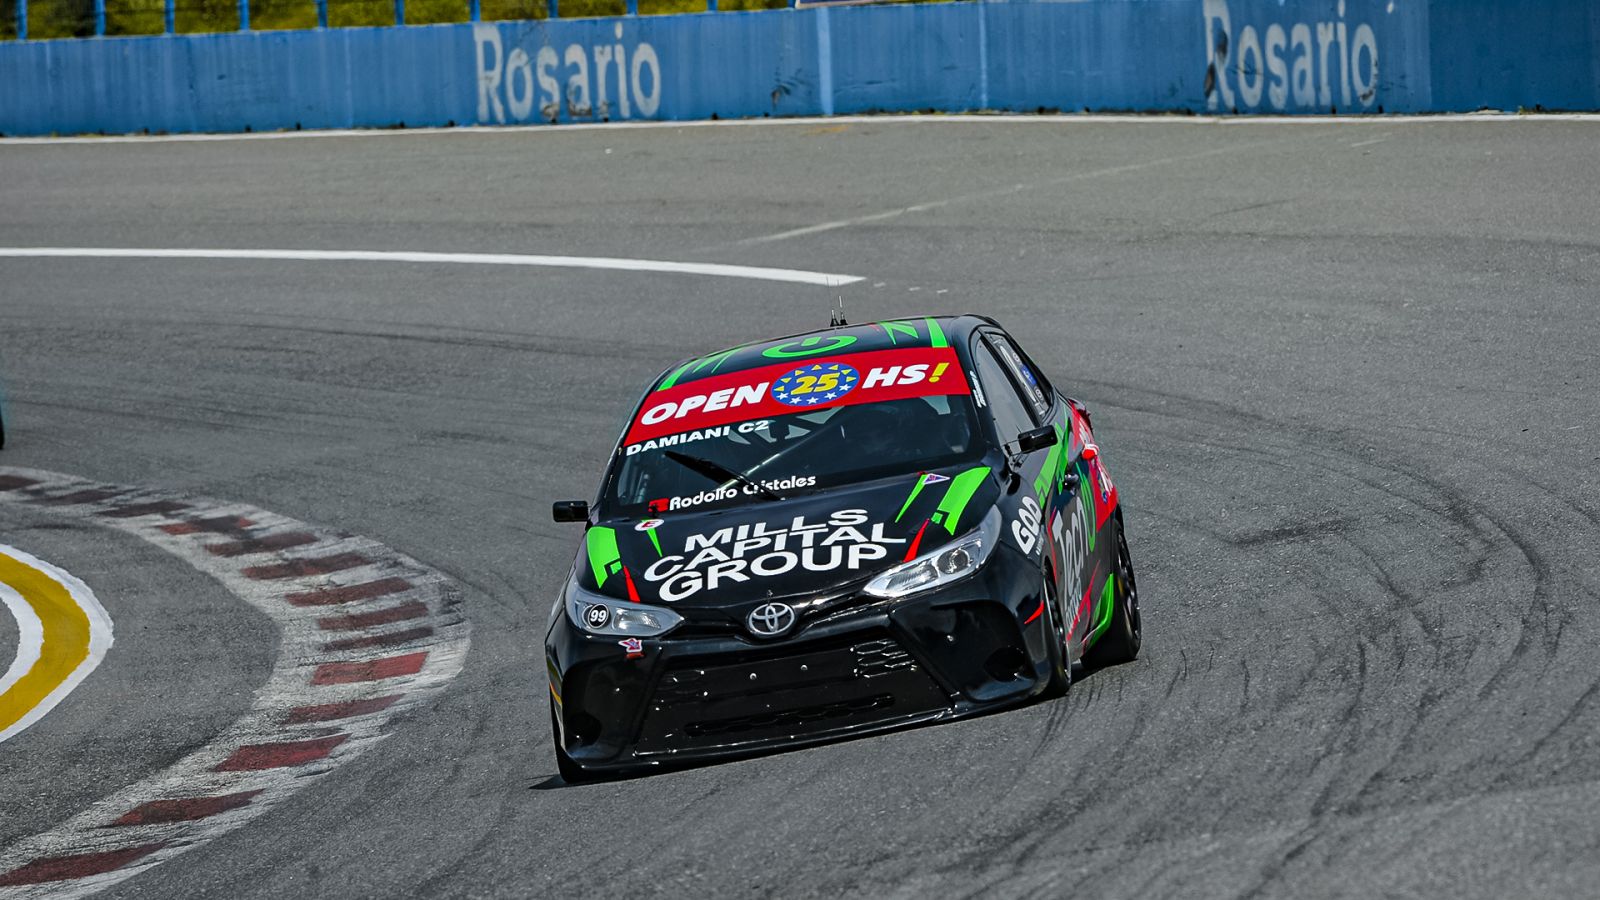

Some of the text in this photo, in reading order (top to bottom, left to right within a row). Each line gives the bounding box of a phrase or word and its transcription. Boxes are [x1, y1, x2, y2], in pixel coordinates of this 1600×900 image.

[473, 22, 661, 123] Rosario
[1203, 0, 1379, 110] Rosario
[641, 382, 769, 426] OPEN
[790, 373, 840, 397] 25
[862, 362, 949, 389] HS!
[626, 420, 769, 456] DAMIANI C2
[669, 487, 738, 511] Rodolfo
[643, 522, 907, 582] CAPITAL
[684, 509, 869, 552] MILLS
[659, 543, 889, 602] GROUP
[590, 610, 607, 622] 99
